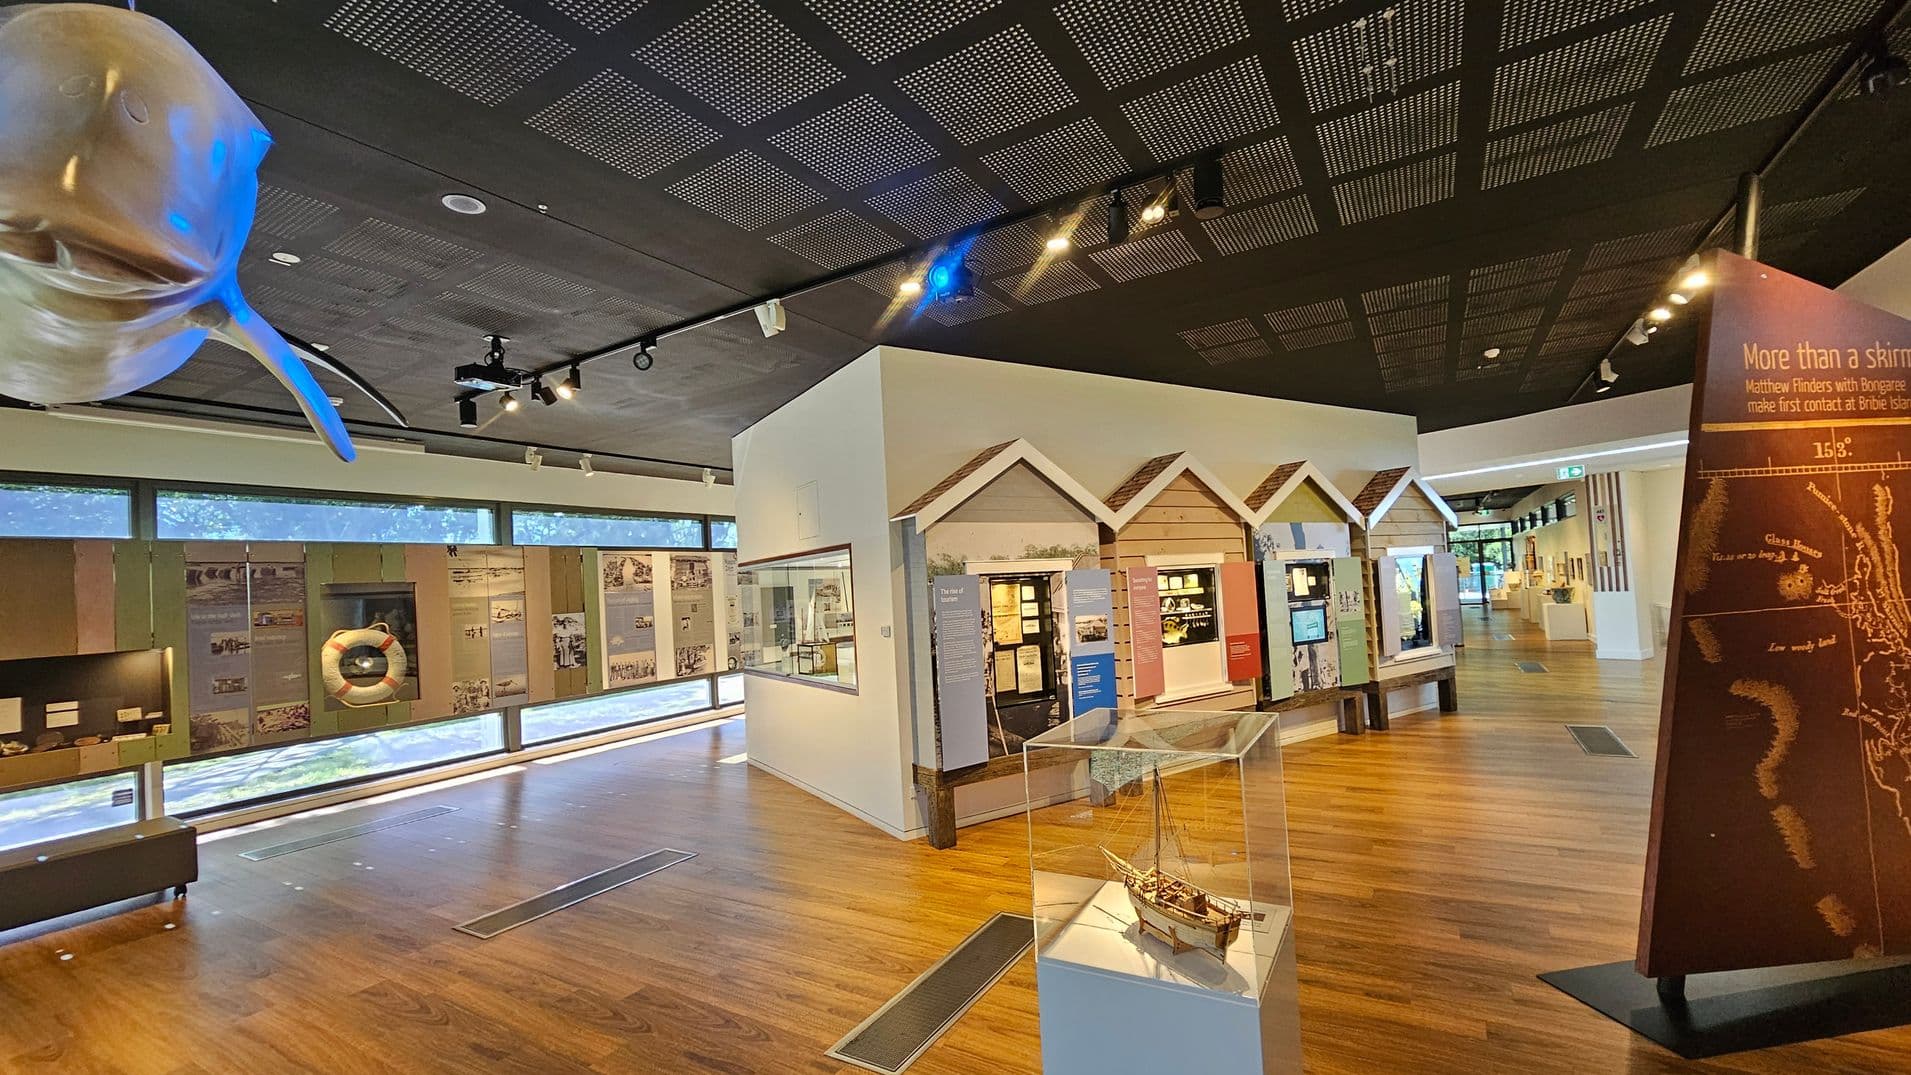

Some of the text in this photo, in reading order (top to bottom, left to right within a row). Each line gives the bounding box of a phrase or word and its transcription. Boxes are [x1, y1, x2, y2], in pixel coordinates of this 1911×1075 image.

[1743, 342, 1790, 370] More
[1796, 340, 1841, 369] than
[1847, 348, 1859, 369] a
[1745, 377, 1906, 395] Matthew Flinders with Bongaree
[1747, 397, 1776, 413] make
[1779, 396, 1801, 412] first
[1804, 398, 1843, 412] contact
[1845, 397, 1856, 411] at
[1859, 395, 1887, 410] Bribie
